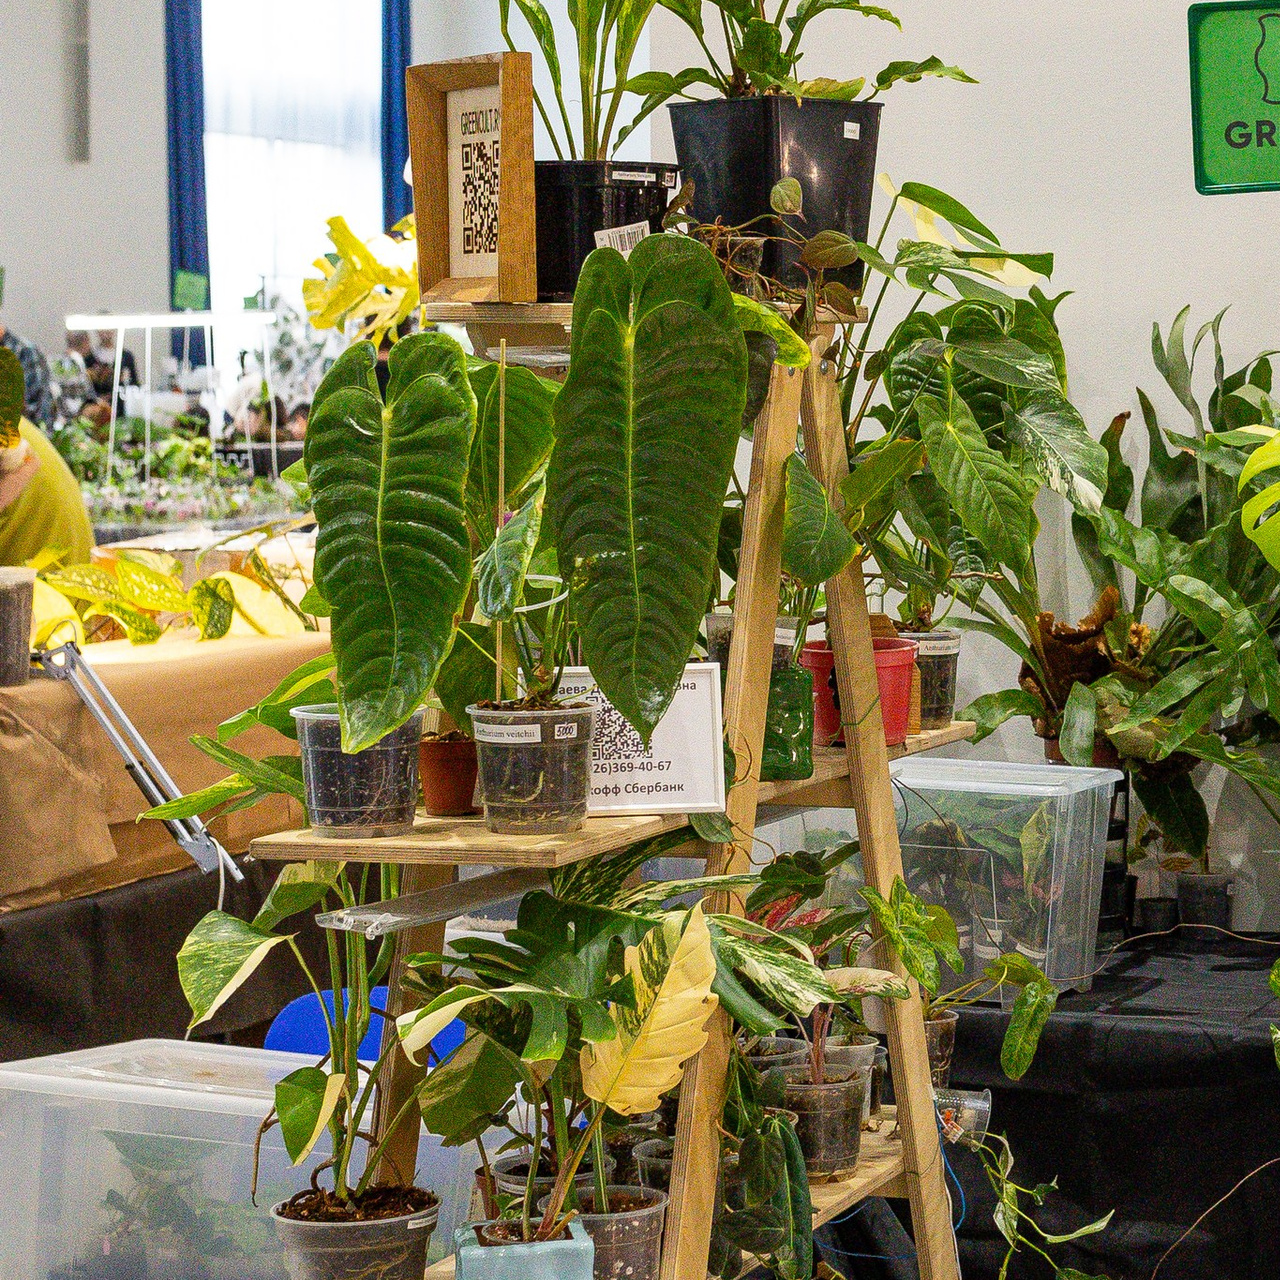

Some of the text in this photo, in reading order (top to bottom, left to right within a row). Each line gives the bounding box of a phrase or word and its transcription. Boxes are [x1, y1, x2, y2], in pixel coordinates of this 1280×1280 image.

[461, 108, 500, 136] GREENCULT.R
[556, 725, 574, 737] 5000
[591, 761, 672, 775] 26)369-40-67
[624, 782, 685, 796] Сбербанк
